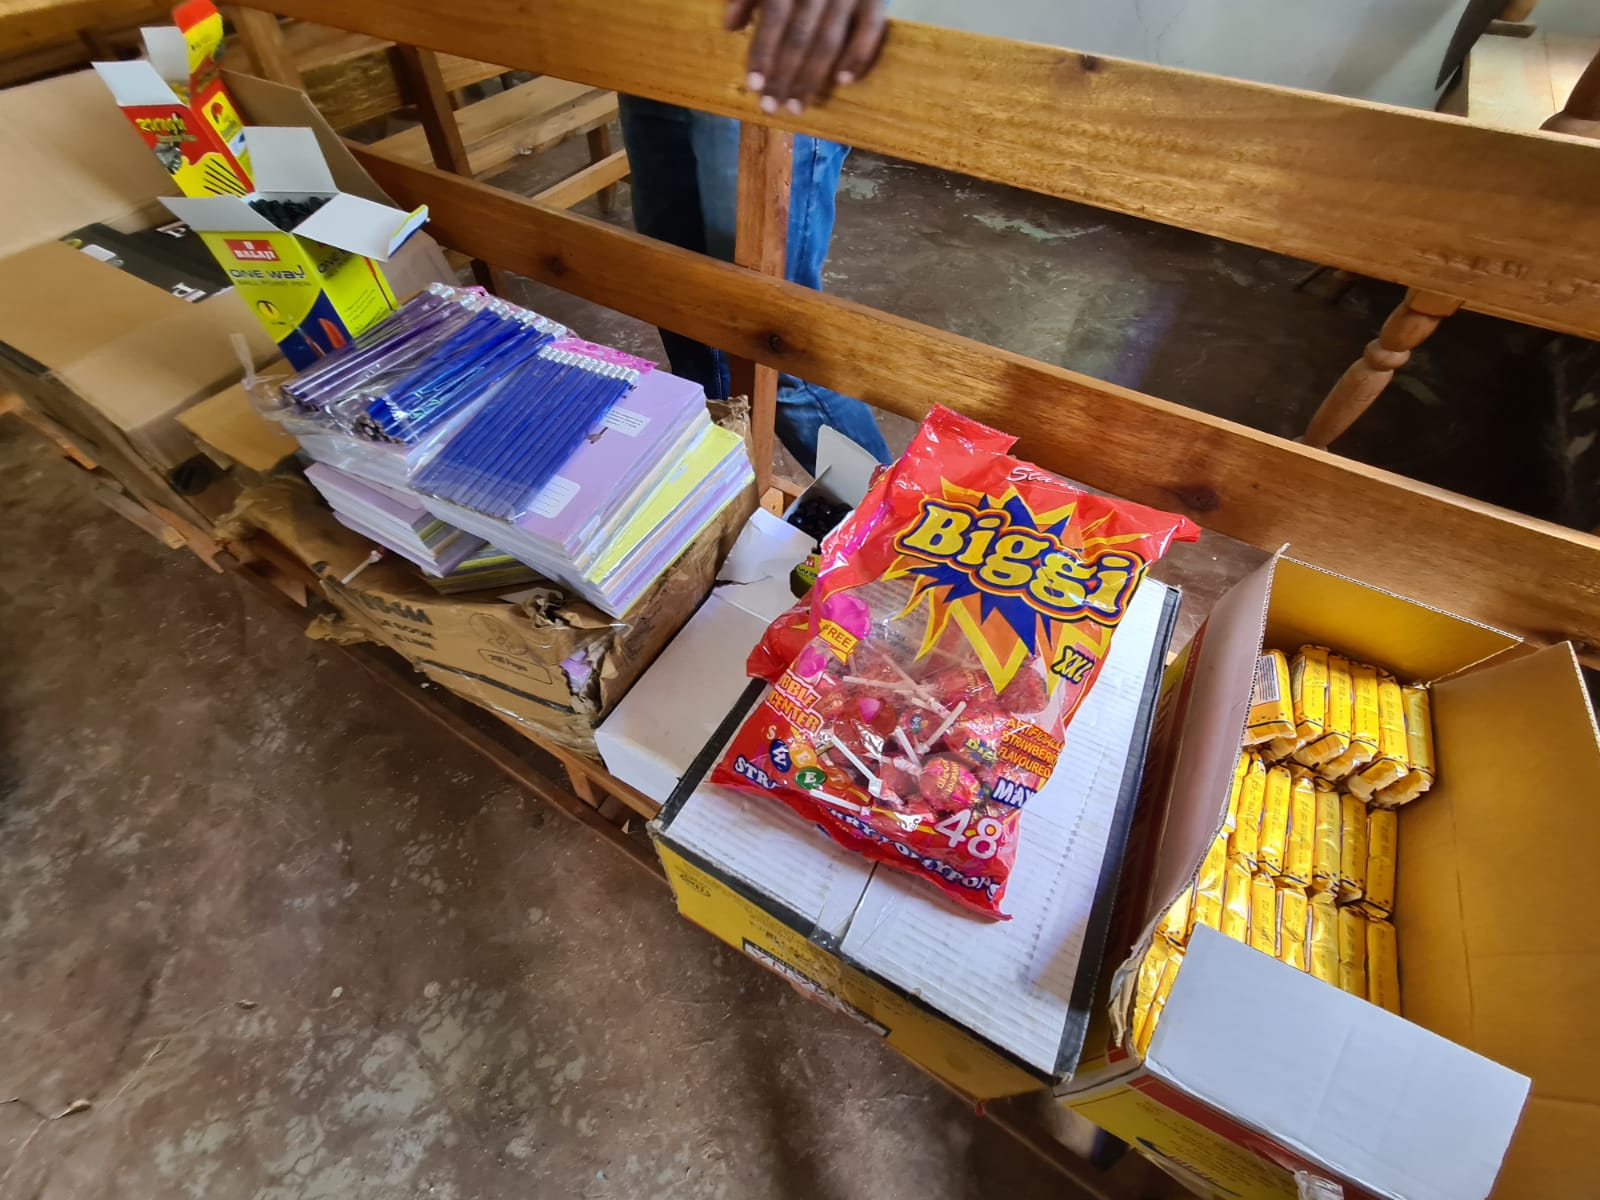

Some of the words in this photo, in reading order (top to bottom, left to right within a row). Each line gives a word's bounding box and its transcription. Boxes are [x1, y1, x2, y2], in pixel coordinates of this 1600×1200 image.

[230, 269, 264, 279] ONE
[900, 501, 1130, 615] Biggi
[1053, 648, 1093, 682] XXL
[767, 689, 820, 732] CENTER
[934, 808, 1003, 860] 48
